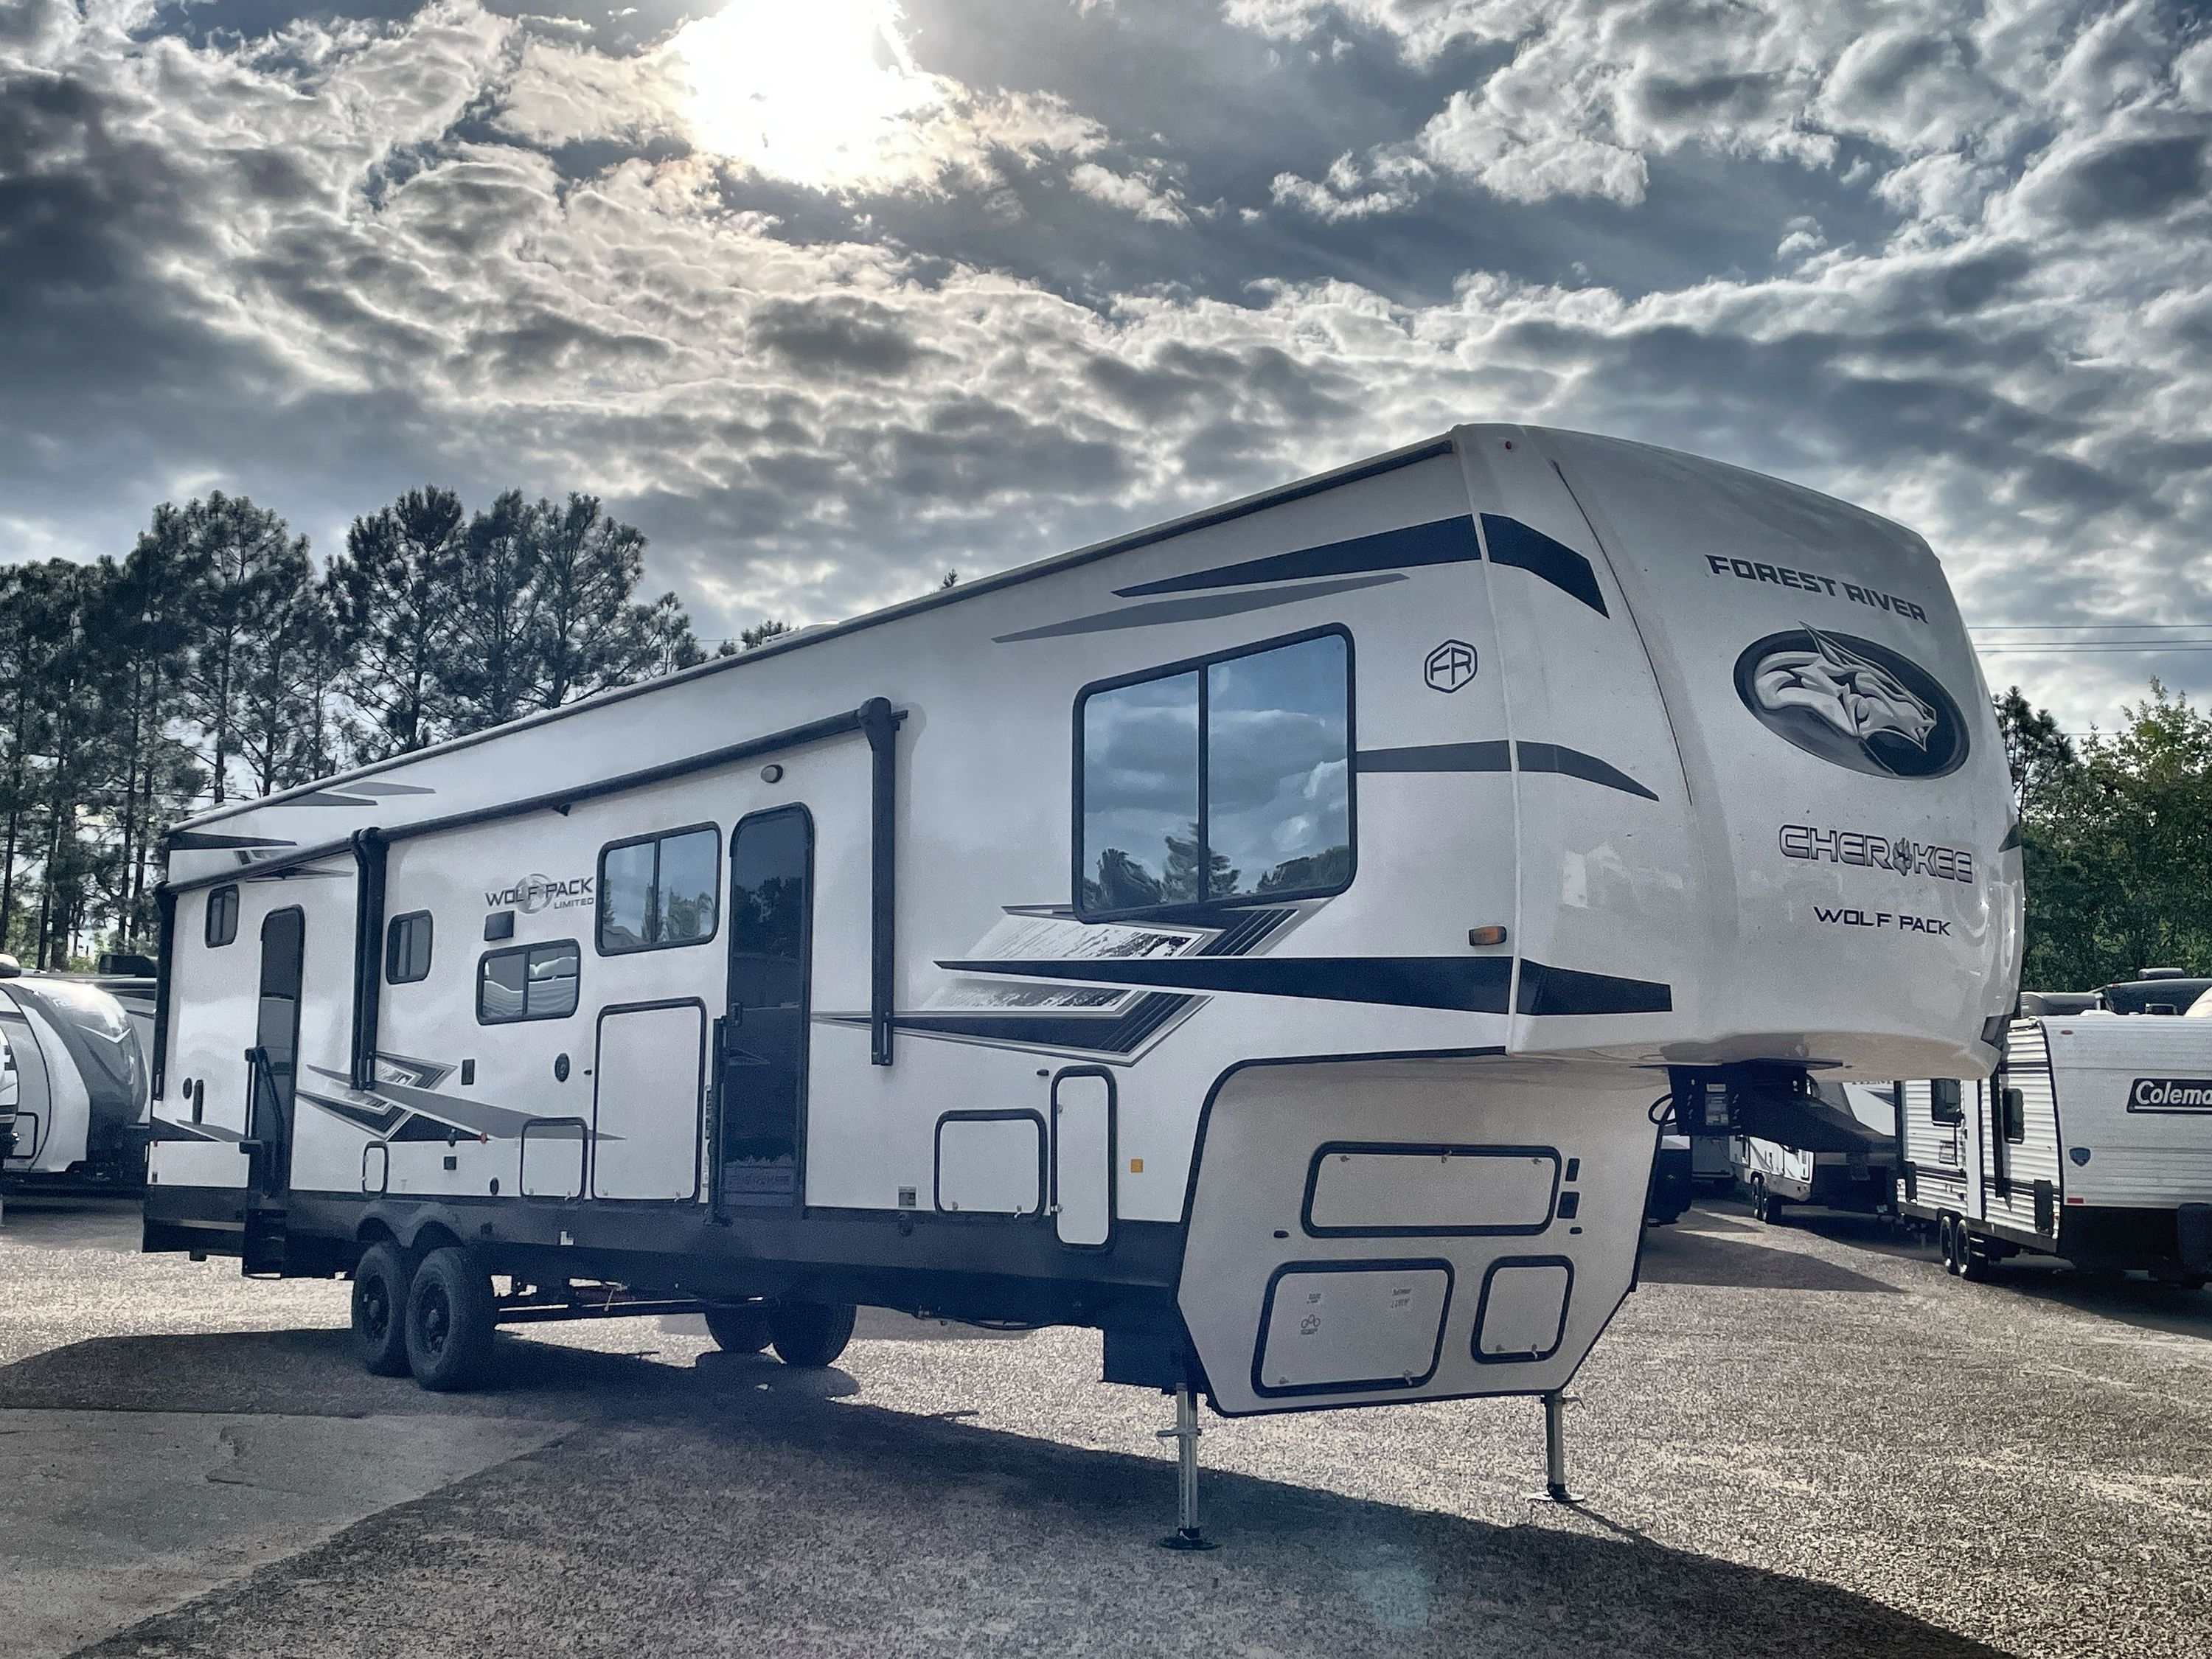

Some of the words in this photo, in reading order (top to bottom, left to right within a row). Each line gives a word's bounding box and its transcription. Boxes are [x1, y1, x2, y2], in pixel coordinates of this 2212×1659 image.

[1705, 554, 1837, 597] FOREST
[1841, 581, 1928, 625] RIVER
[485, 885, 539, 907] WOLF
[546, 877, 594, 898] PACK
[554, 897, 594, 910] LIMITED
[1813, 905, 1892, 928] WOLF
[1898, 914, 1951, 936] PACK
